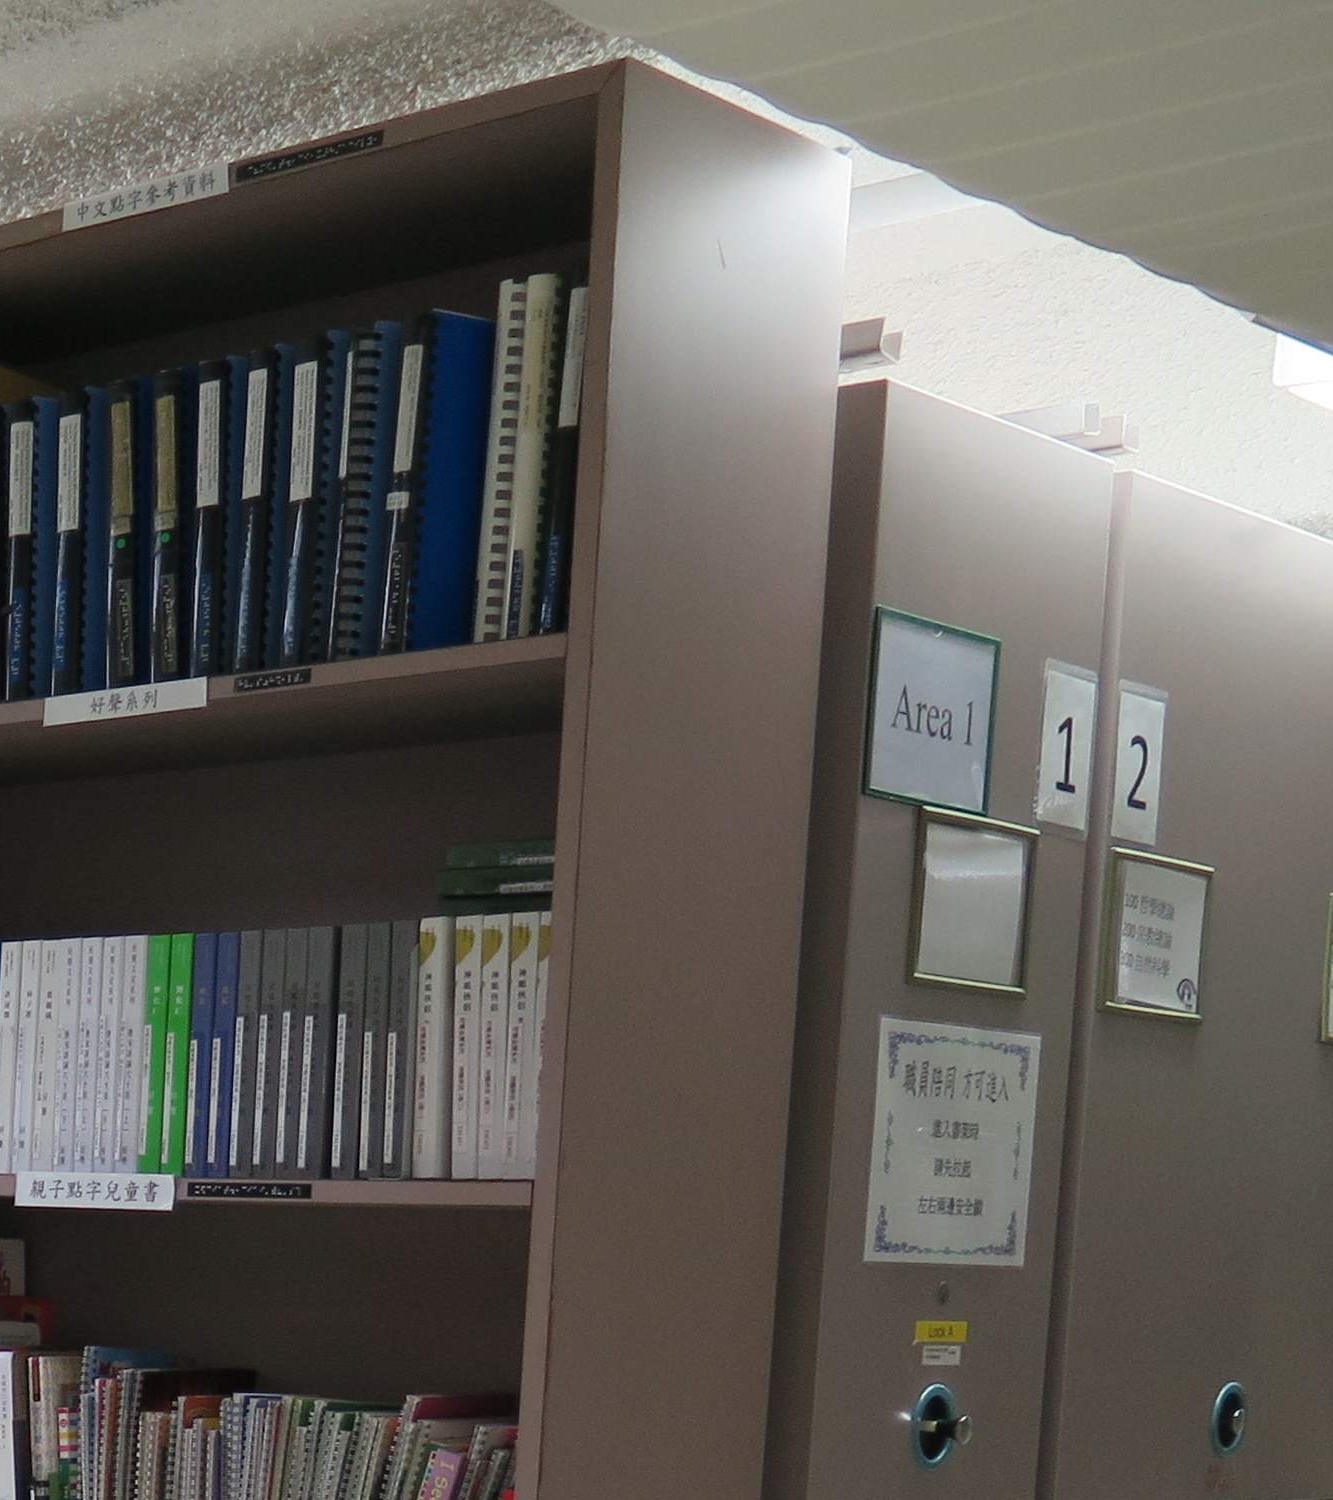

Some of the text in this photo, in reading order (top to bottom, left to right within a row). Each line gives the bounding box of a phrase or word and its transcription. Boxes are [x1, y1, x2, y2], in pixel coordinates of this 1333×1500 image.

[77, 171, 216, 222] 中文點字參考資料
[891, 685, 974, 746] Area 1
[1056, 717, 1076, 793] 1
[1127, 735, 1149, 810] 2
[28, 1177, 159, 1203] 親子點字兒童書
